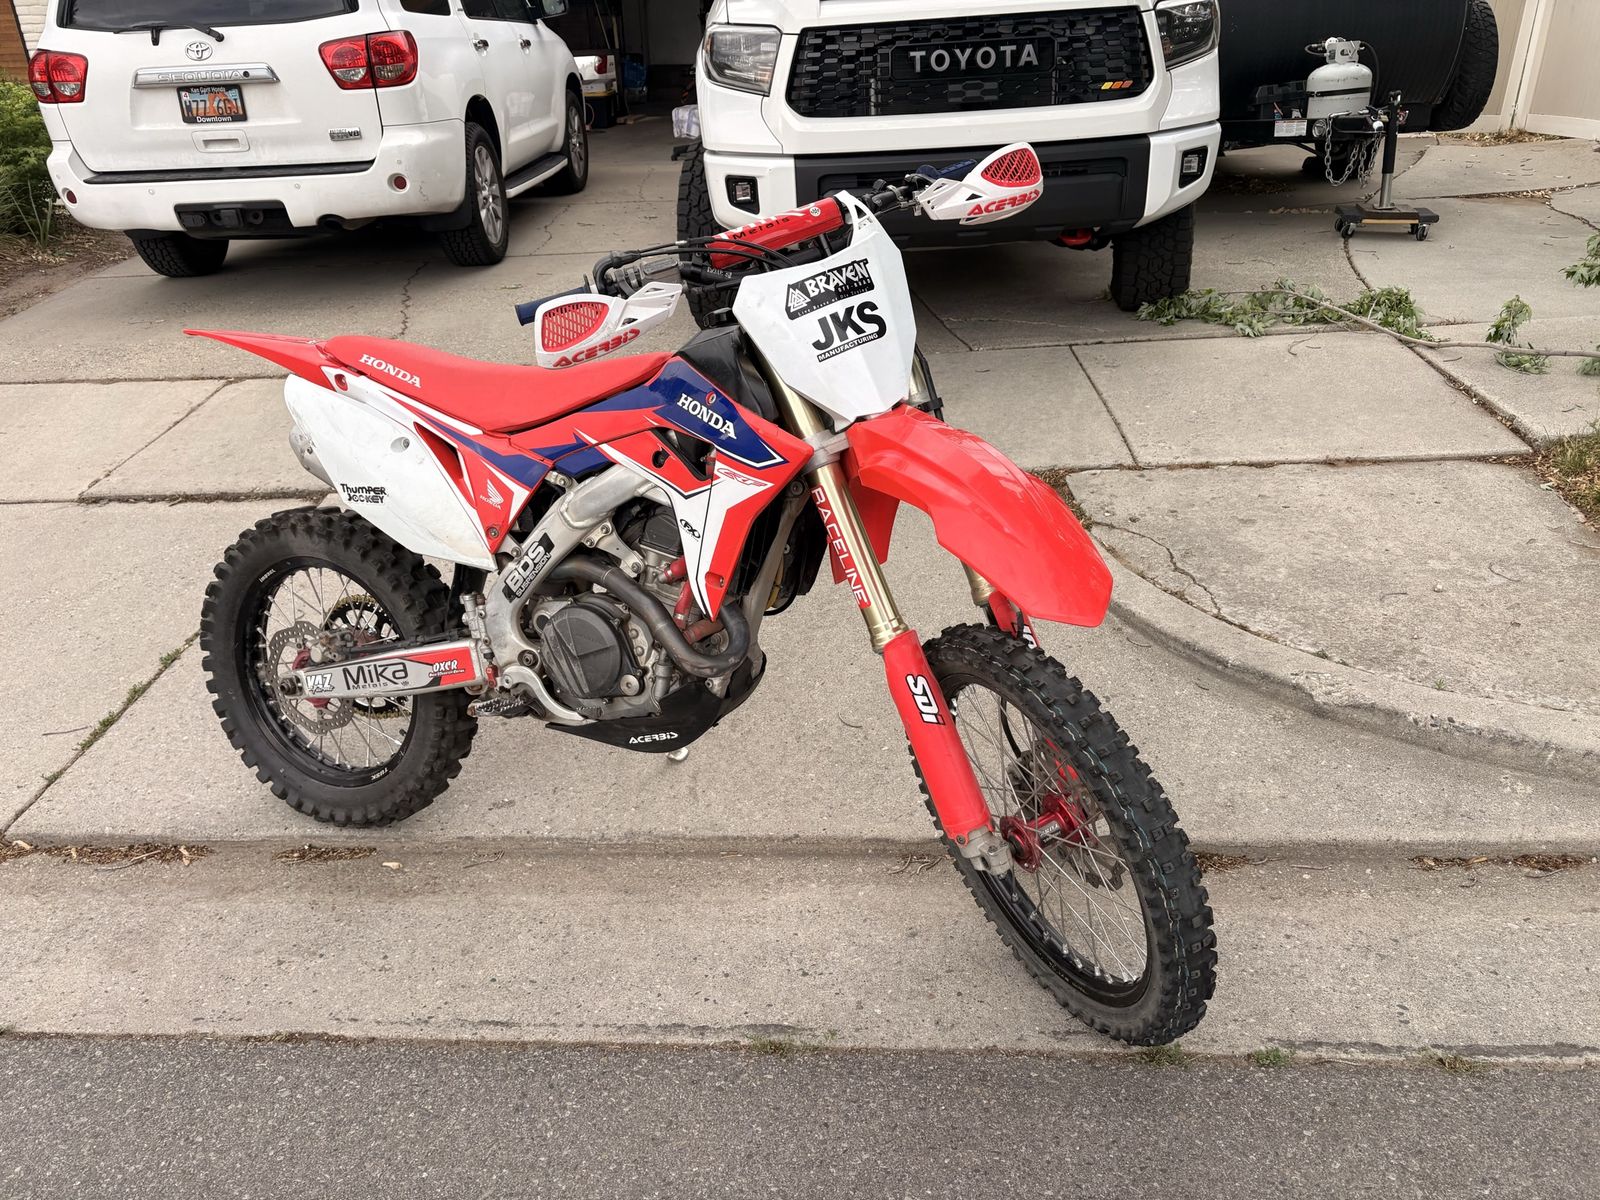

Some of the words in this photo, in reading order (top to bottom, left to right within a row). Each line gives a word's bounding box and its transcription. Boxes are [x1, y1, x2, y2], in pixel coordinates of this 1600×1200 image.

[909, 43, 1039, 73] TOYOTA
[157, 70, 243, 83] SEQUOIA
[732, 216, 791, 240] Metals
[811, 300, 887, 351] JKS
[818, 332, 879, 361] MANUFACTURING
[359, 353, 422, 388] HONDA
[677, 393, 737, 440] HONDA
[811, 486, 868, 605] RACELINE
[504, 541, 546, 594] BDS
[515, 551, 552, 598] SUSPENSION
[342, 661, 409, 691] Mika
[352, 682, 388, 691] Metals
